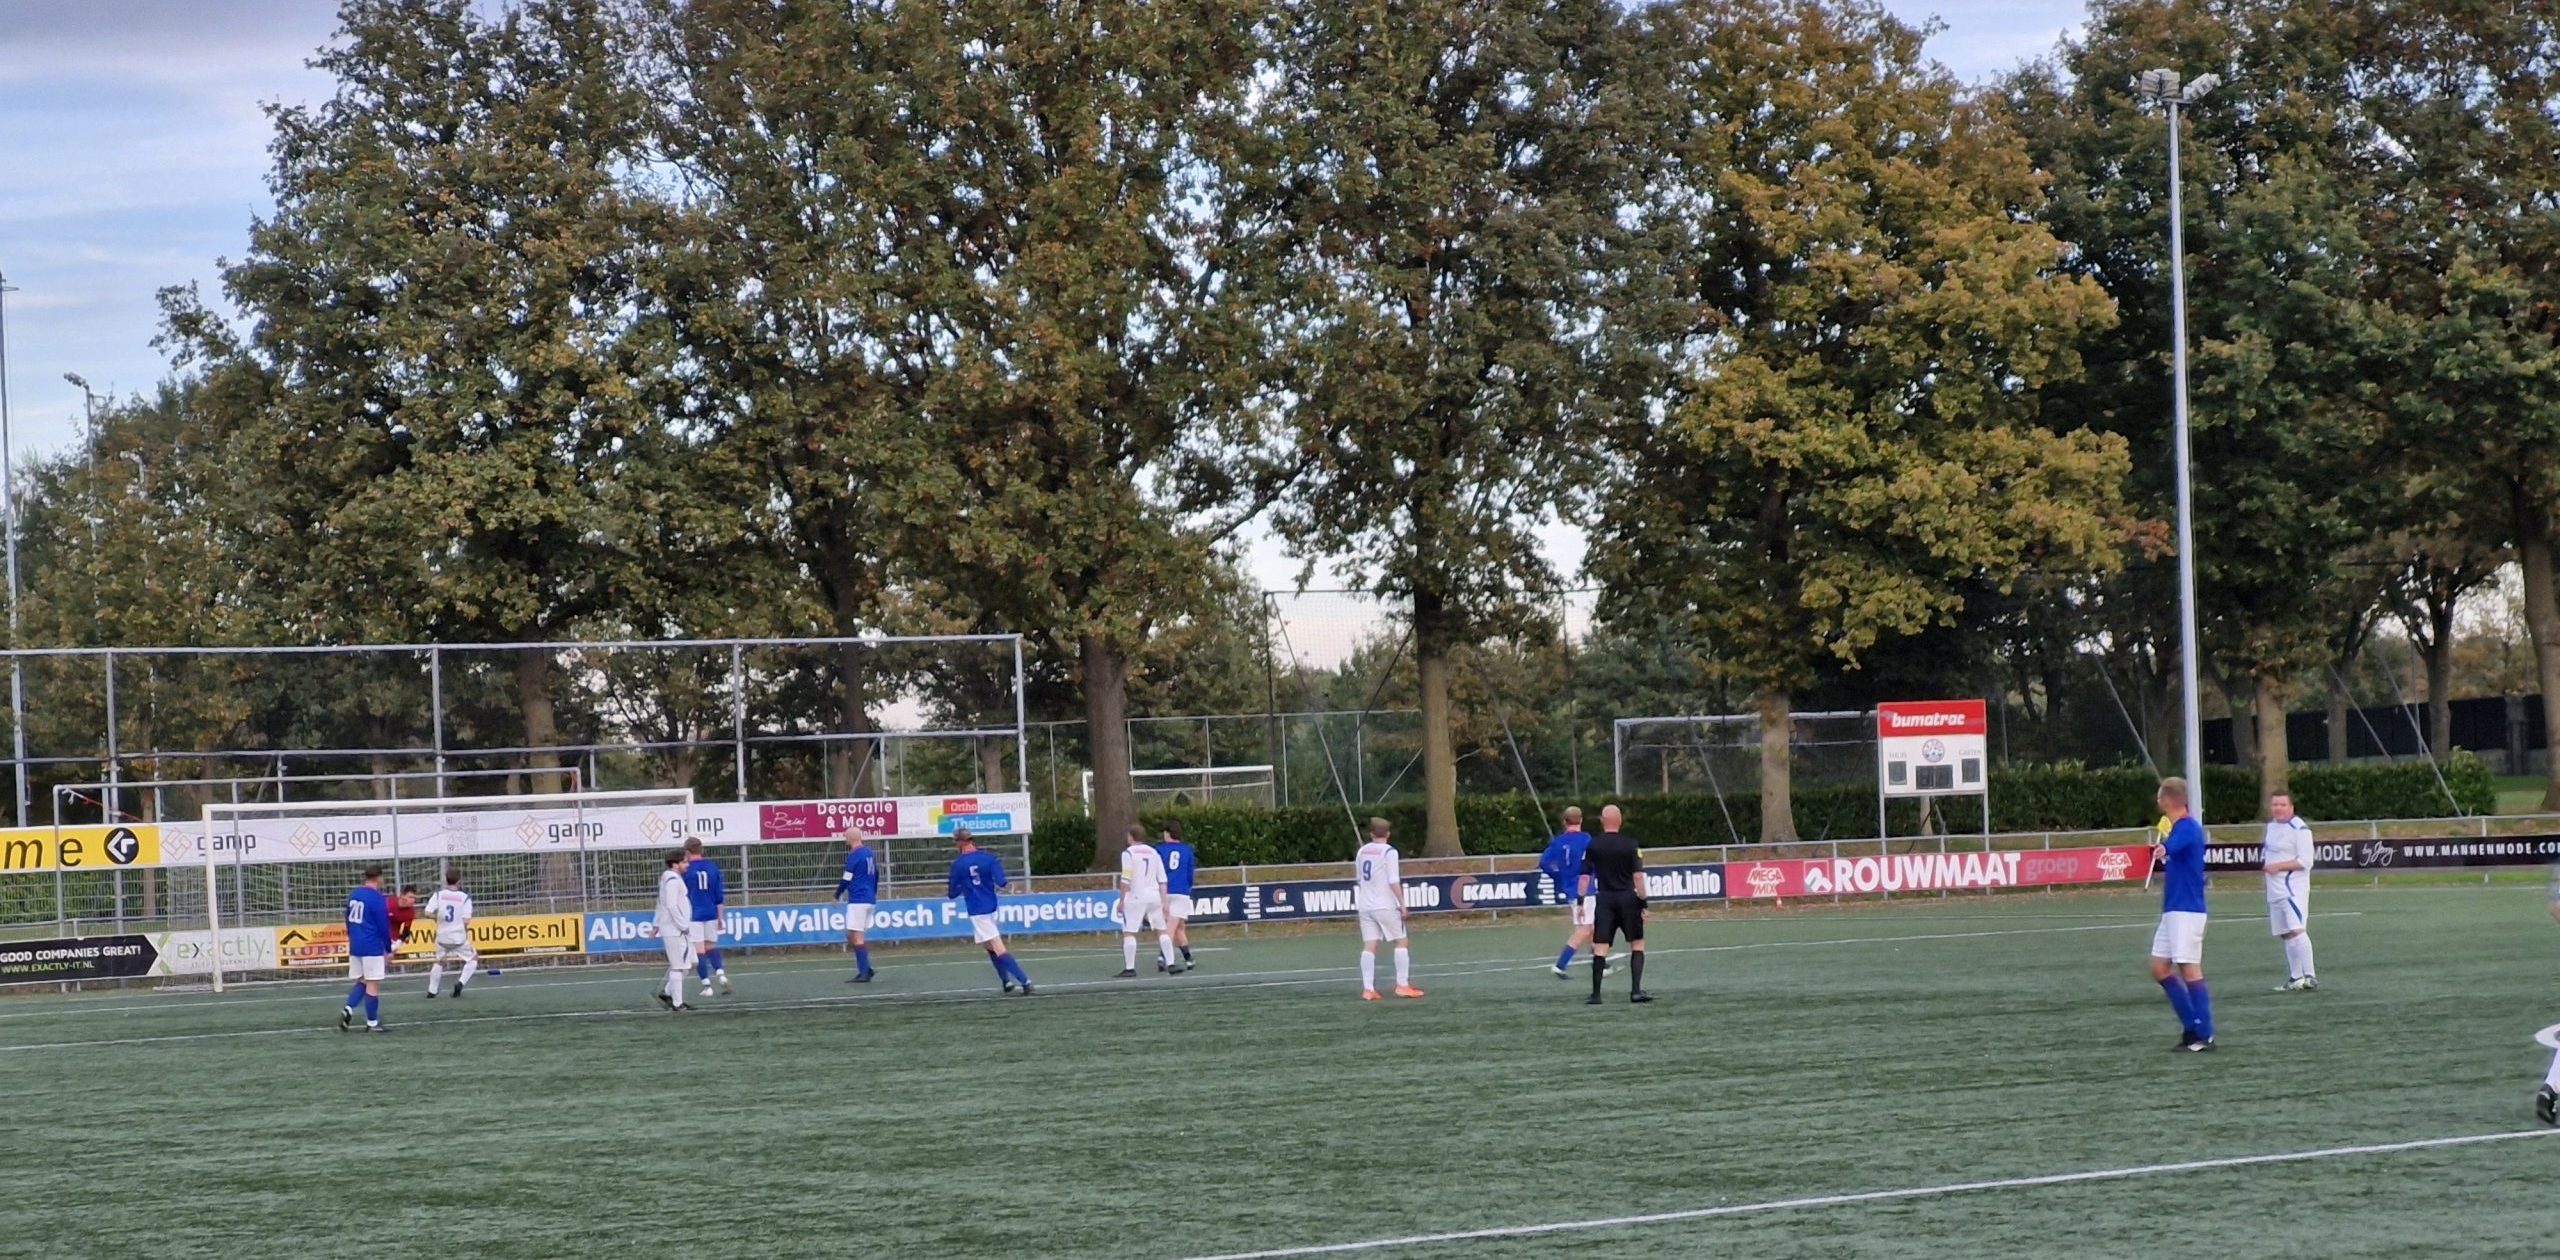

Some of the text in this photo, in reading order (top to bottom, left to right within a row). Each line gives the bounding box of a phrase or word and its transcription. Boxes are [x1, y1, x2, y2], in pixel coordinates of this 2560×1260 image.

[1891, 711, 1966, 729] bumatrac
[817, 801, 893, 816] Decoratie
[825, 816, 836, 829] &
[842, 814, 885, 829] Mode
[951, 817, 1009, 831] Theissen
[323, 829, 382, 852] gamp
[548, 820, 604, 844] gamp
[1169, 850, 1180, 870] 6
[2100, 854, 2130, 867] MEGA
[2202, 847, 2245, 864] MMEN
[969, 865, 981, 885] 5
[1142, 857, 1150, 877] 7
[1362, 859, 1373, 882] 9
[1749, 868, 1783, 883] MEGA
[1834, 852, 2079, 893] ROUWMAAT groep
[2104, 867, 2125, 878] MIX
[1462, 881, 1528, 902] KAAK
[1642, 868, 1721, 898] kaak.info
[1754, 883, 1777, 895] MIX
[1303, 881, 1440, 913] www.info
[348, 899, 365, 925] 20
[445, 904, 455, 923] 3
[588, 916, 662, 942] Albe
[715, 911, 760, 942] eijn
[941, 896, 1108, 929] F-mpetitie
[0, 944, 142, 964] GOOD COMPANIES GREAT!
[282, 943, 347, 957] HUBE
